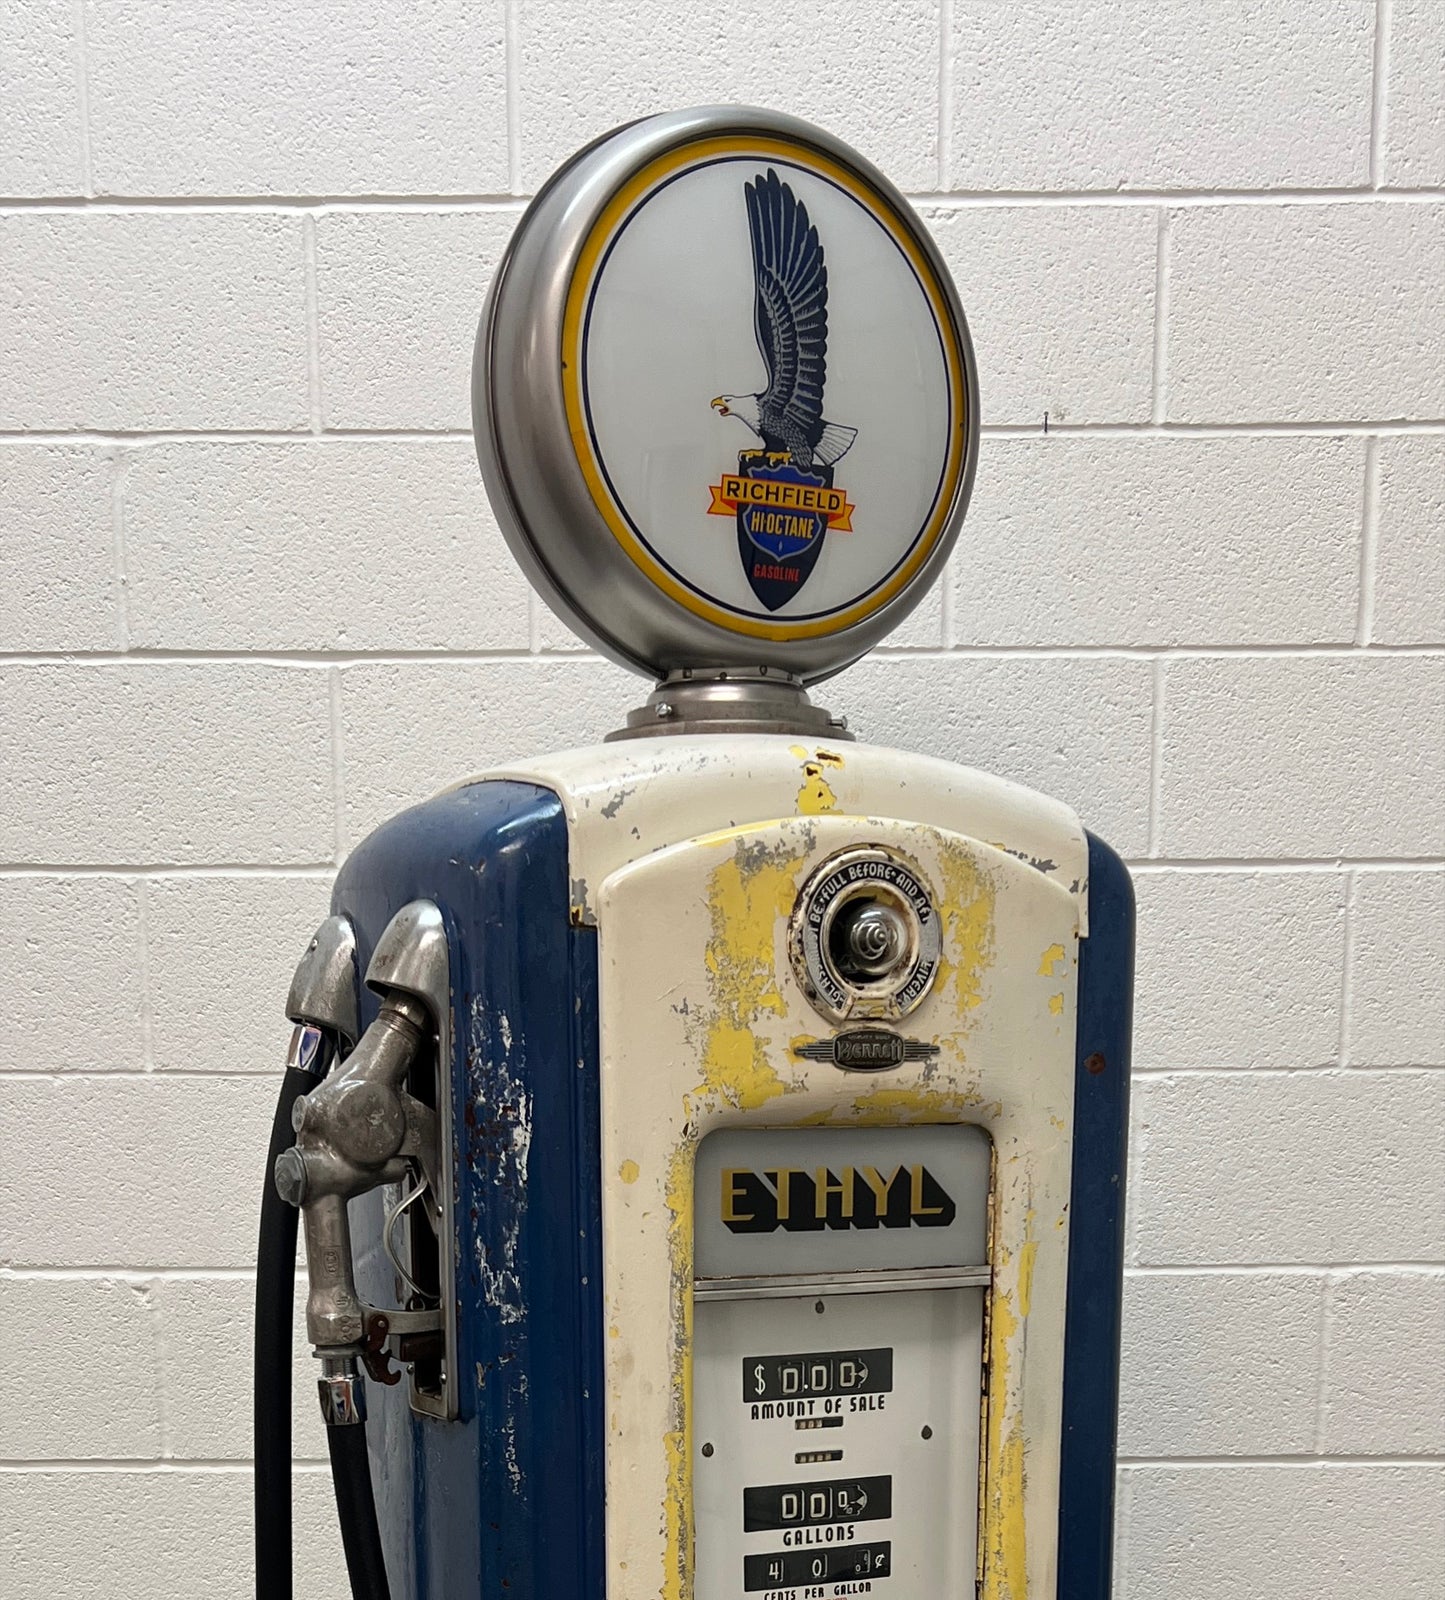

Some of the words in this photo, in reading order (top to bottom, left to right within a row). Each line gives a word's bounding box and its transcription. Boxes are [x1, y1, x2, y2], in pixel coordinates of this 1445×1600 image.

[726, 480, 840, 510] RICHFIELD
[753, 563, 800, 582] GASOLINE
[810, 903, 824, 923] BE
[821, 873, 848, 900] FULL
[849, 862, 891, 880] BEFORE
[896, 874, 918, 897] AND
[720, 1163, 948, 1225] ETHYL
[754, 1363, 766, 1395] $
[751, 1400, 815, 1420] AMOUNT
[824, 1397, 842, 1414] OF
[850, 1394, 885, 1412] SALE
[783, 1525, 855, 1546] GALLONS
[804, 1586, 825, 1600] PER
[834, 1581, 871, 1596] GALLON
